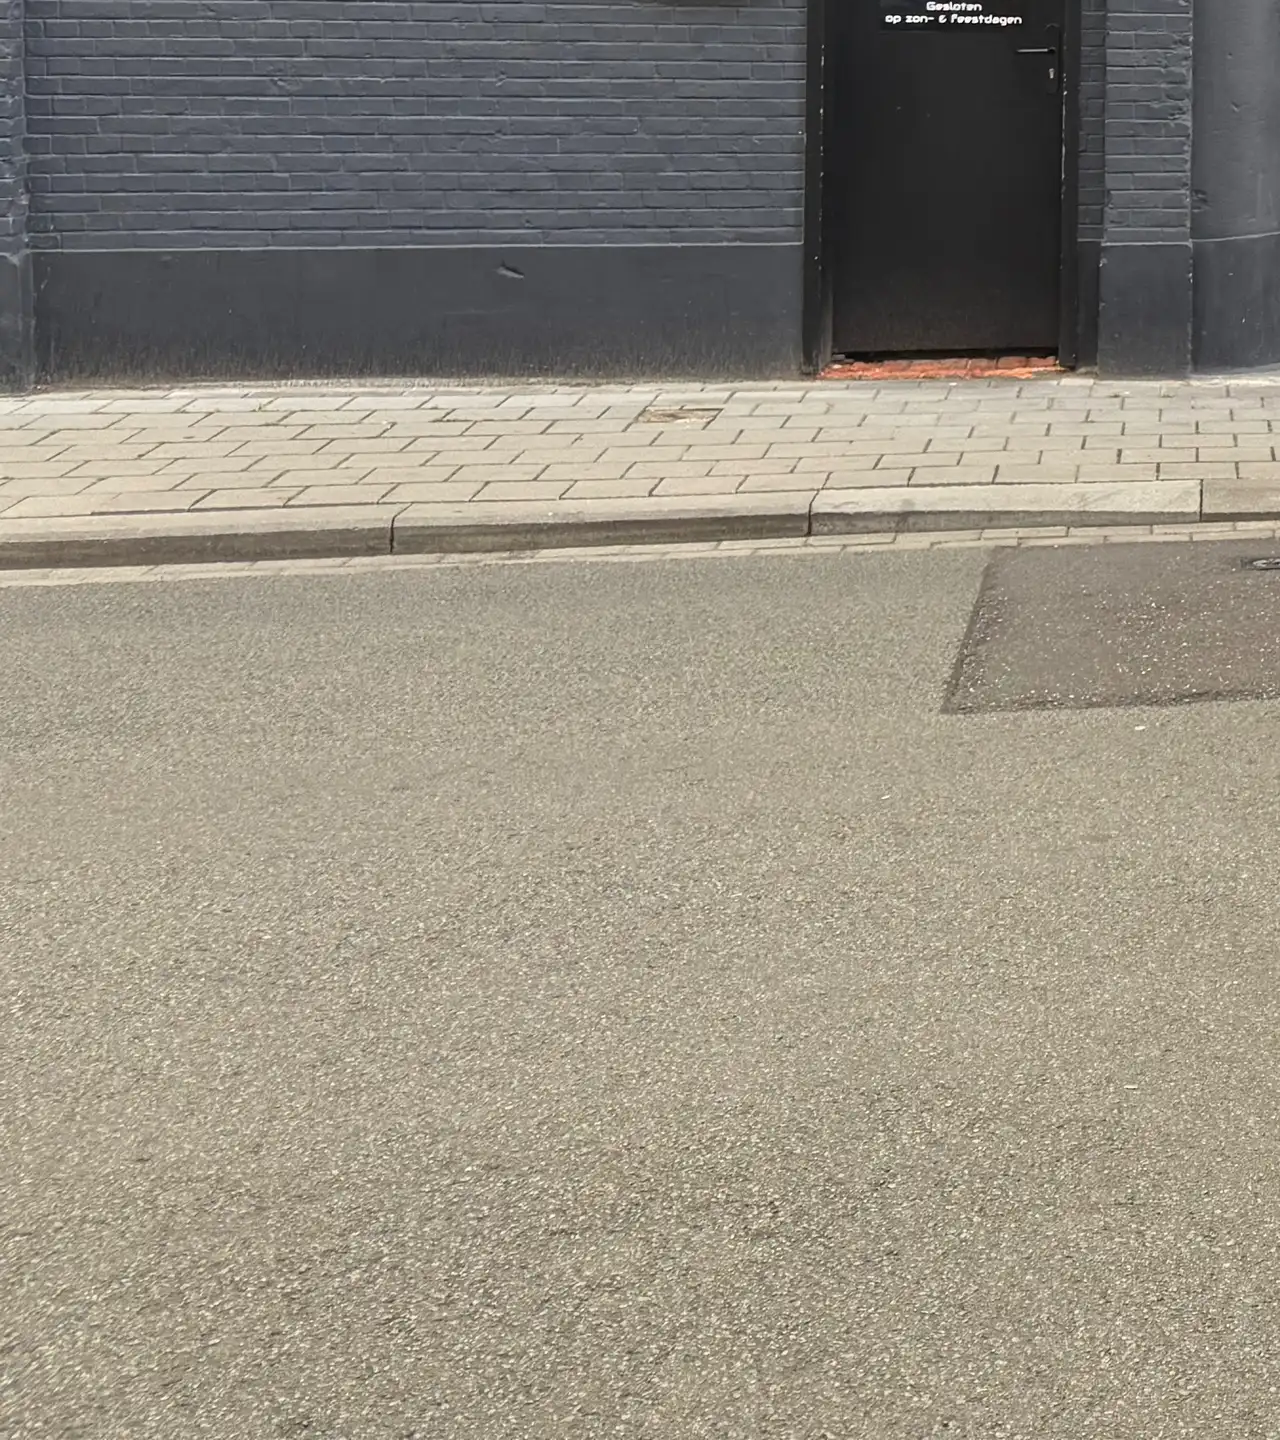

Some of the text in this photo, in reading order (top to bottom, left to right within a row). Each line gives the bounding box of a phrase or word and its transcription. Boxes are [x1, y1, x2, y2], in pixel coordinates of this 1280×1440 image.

[927, 2, 982, 11] Gesloten
[885, 15, 901, 24] op
[951, 14, 1022, 26] feestdagen
